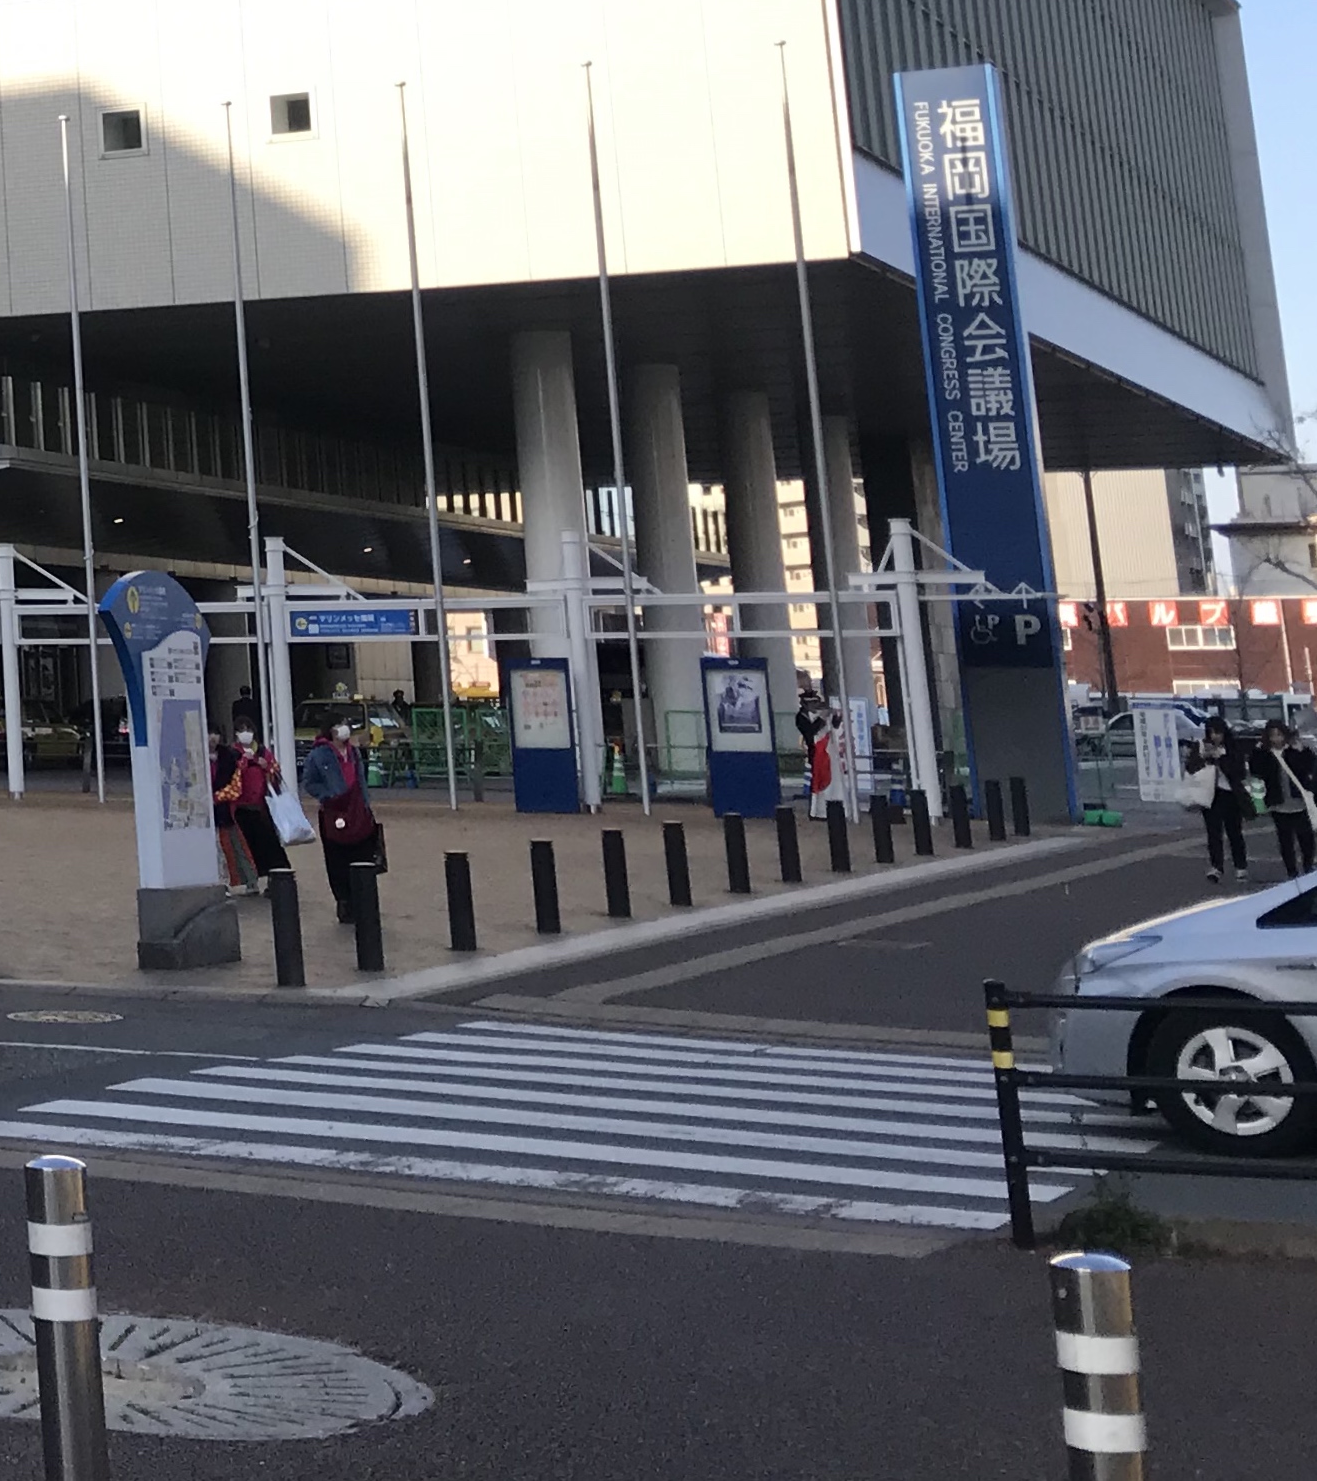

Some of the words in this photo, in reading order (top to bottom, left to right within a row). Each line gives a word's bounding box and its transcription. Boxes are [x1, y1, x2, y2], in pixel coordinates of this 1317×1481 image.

[914, 101, 935, 175] FUKUOKA
[922, 183, 950, 303] INTERNATIONAL
[937, 99, 1021, 471] 福岡国際会議場
[937, 313, 961, 400] CONGRESS
[947, 411, 969, 473] CENTER
[1014, 614, 1041, 645] P
